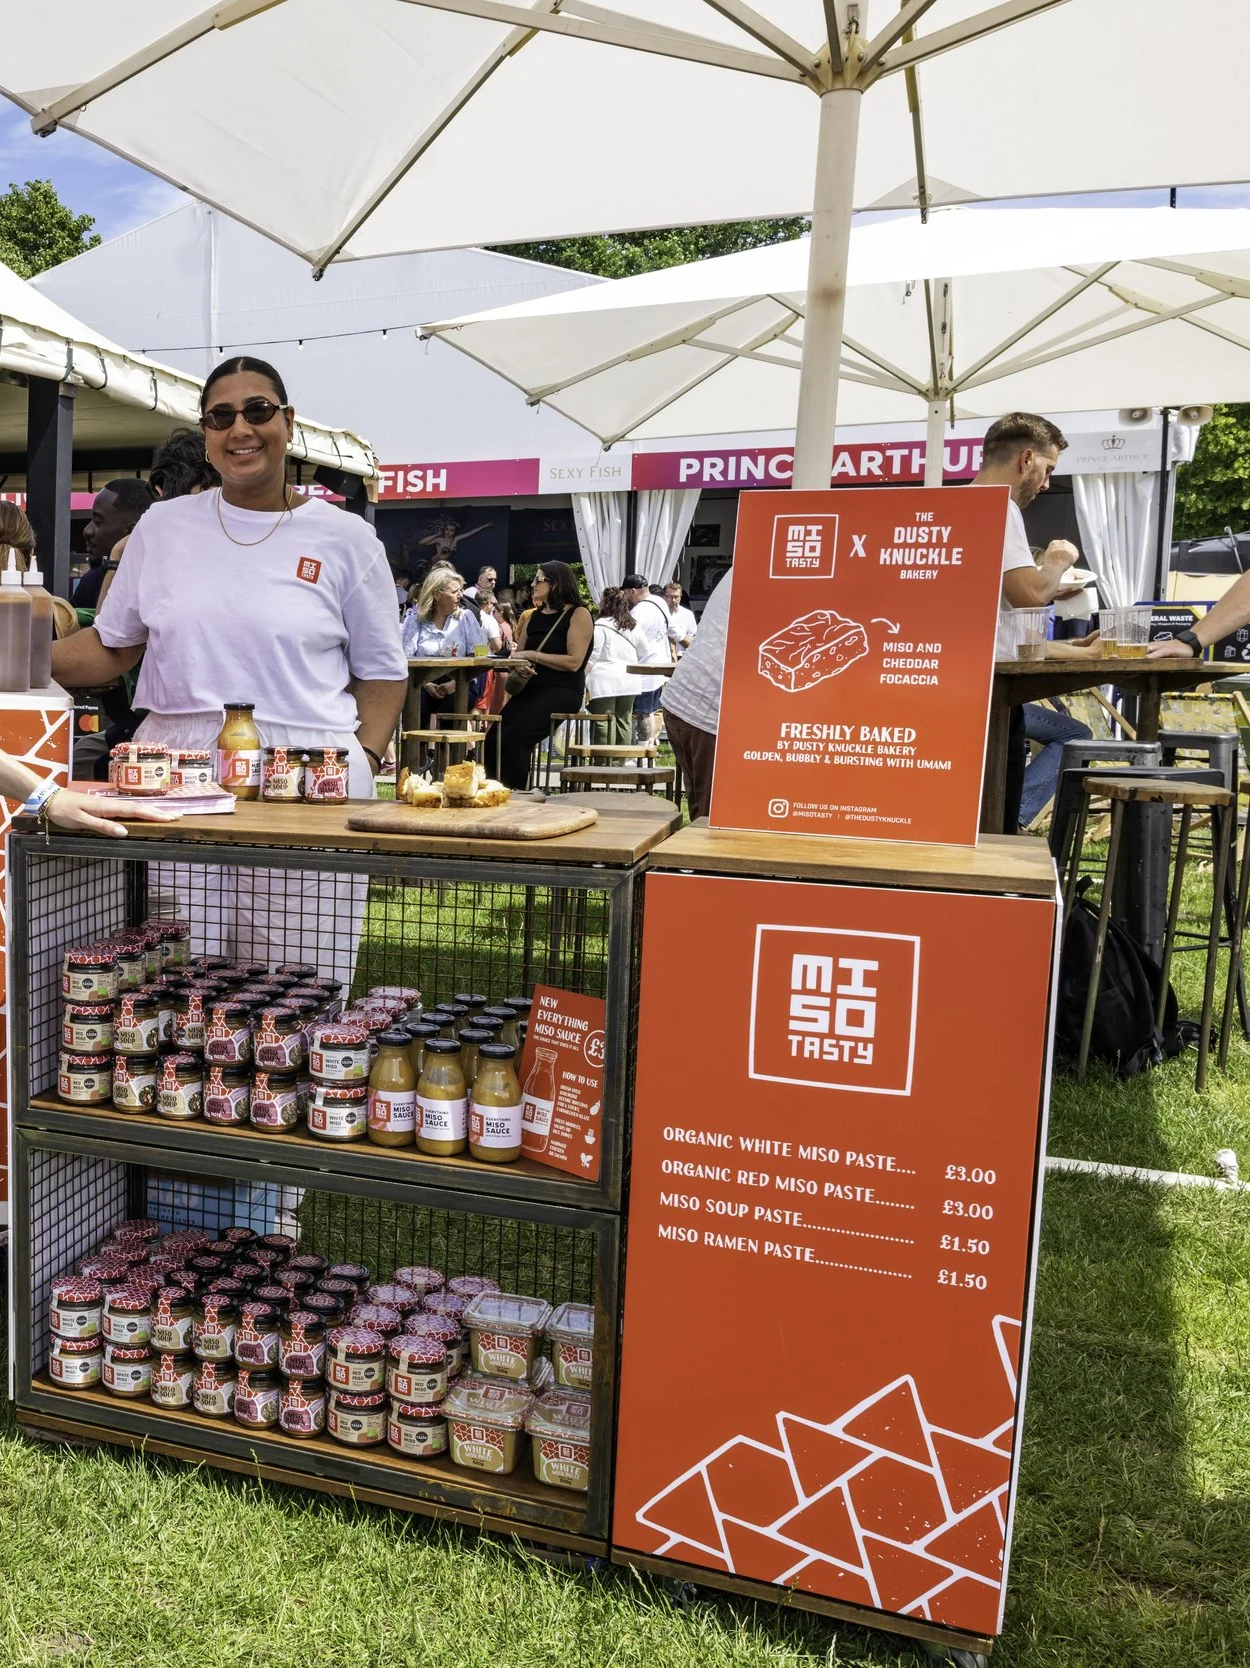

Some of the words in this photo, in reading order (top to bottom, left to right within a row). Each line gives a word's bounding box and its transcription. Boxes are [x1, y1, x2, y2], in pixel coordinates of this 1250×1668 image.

[550, 468, 584, 479] SEXY
[590, 466, 621, 477] FISH
[679, 454, 794, 482] PRINC
[379, 469, 447, 493] FISH
[915, 512, 934, 522] THE
[893, 526, 952, 544] DUSTY
[850, 535, 867, 557] X
[786, 558, 820, 568] TASTY
[879, 547, 963, 565] KNUCKLE
[900, 570, 938, 579] BAKERY
[883, 642, 913, 653] MISO
[916, 643, 942, 653] AND
[882, 658, 939, 669] CHEDDAR
[879, 674, 939, 685] FOCACCIA
[780, 723, 855, 741] FRESHLY
[860, 725, 917, 743] BAKED
[777, 741, 791, 750] BY
[793, 741, 826, 751] DUSTY
[828, 743, 875, 754] KNUCKLE
[877, 745, 917, 756] BAKERY
[743, 751, 783, 762] GOLDEN,
[786, 752, 822, 764] BUBBLY
[824, 755, 831, 764] &
[833, 755, 883, 767] BURSTING
[886, 757, 914, 768] WITH
[917, 759, 951, 770] UMAMI
[792, 811, 833, 819] @MISOTASTY
[845, 814, 912, 824] @THEDUSTYKNUCKLE
[840, 805, 877, 813] INSTAGRAM
[540, 996, 558, 1009] NEW
[537, 1009, 589, 1031] EVERYTHING
[534, 1023, 555, 1036] MISO
[556, 1029, 582, 1044] SAUCE
[788, 1034, 874, 1065] TASTY
[562, 1071, 576, 1081] HOW
[578, 1075, 585, 1084] TO
[586, 1077, 599, 1088] USE
[663, 1126, 733, 1150] ORGANIC
[739, 1136, 793, 1158] WHITE
[797, 1144, 840, 1165] MISO
[945, 1164, 997, 1185] £3.00
[661, 1159, 731, 1183] ORGANIC
[737, 1170, 770, 1189] RED
[775, 1176, 818, 1196] MISO
[942, 1199, 994, 1221] £3.00
[659, 1191, 700, 1212] MISO
[705, 1199, 749, 1219] SOUP
[940, 1234, 990, 1256] £1.50
[658, 1224, 698, 1244] MISO
[704, 1231, 758, 1255] RAMEN
[937, 1269, 988, 1291] £1.50
[488, 1352, 517, 1366] WHITE
[463, 1444, 493, 1458] WHITE
[550, 1462, 582, 1474] WHITE
